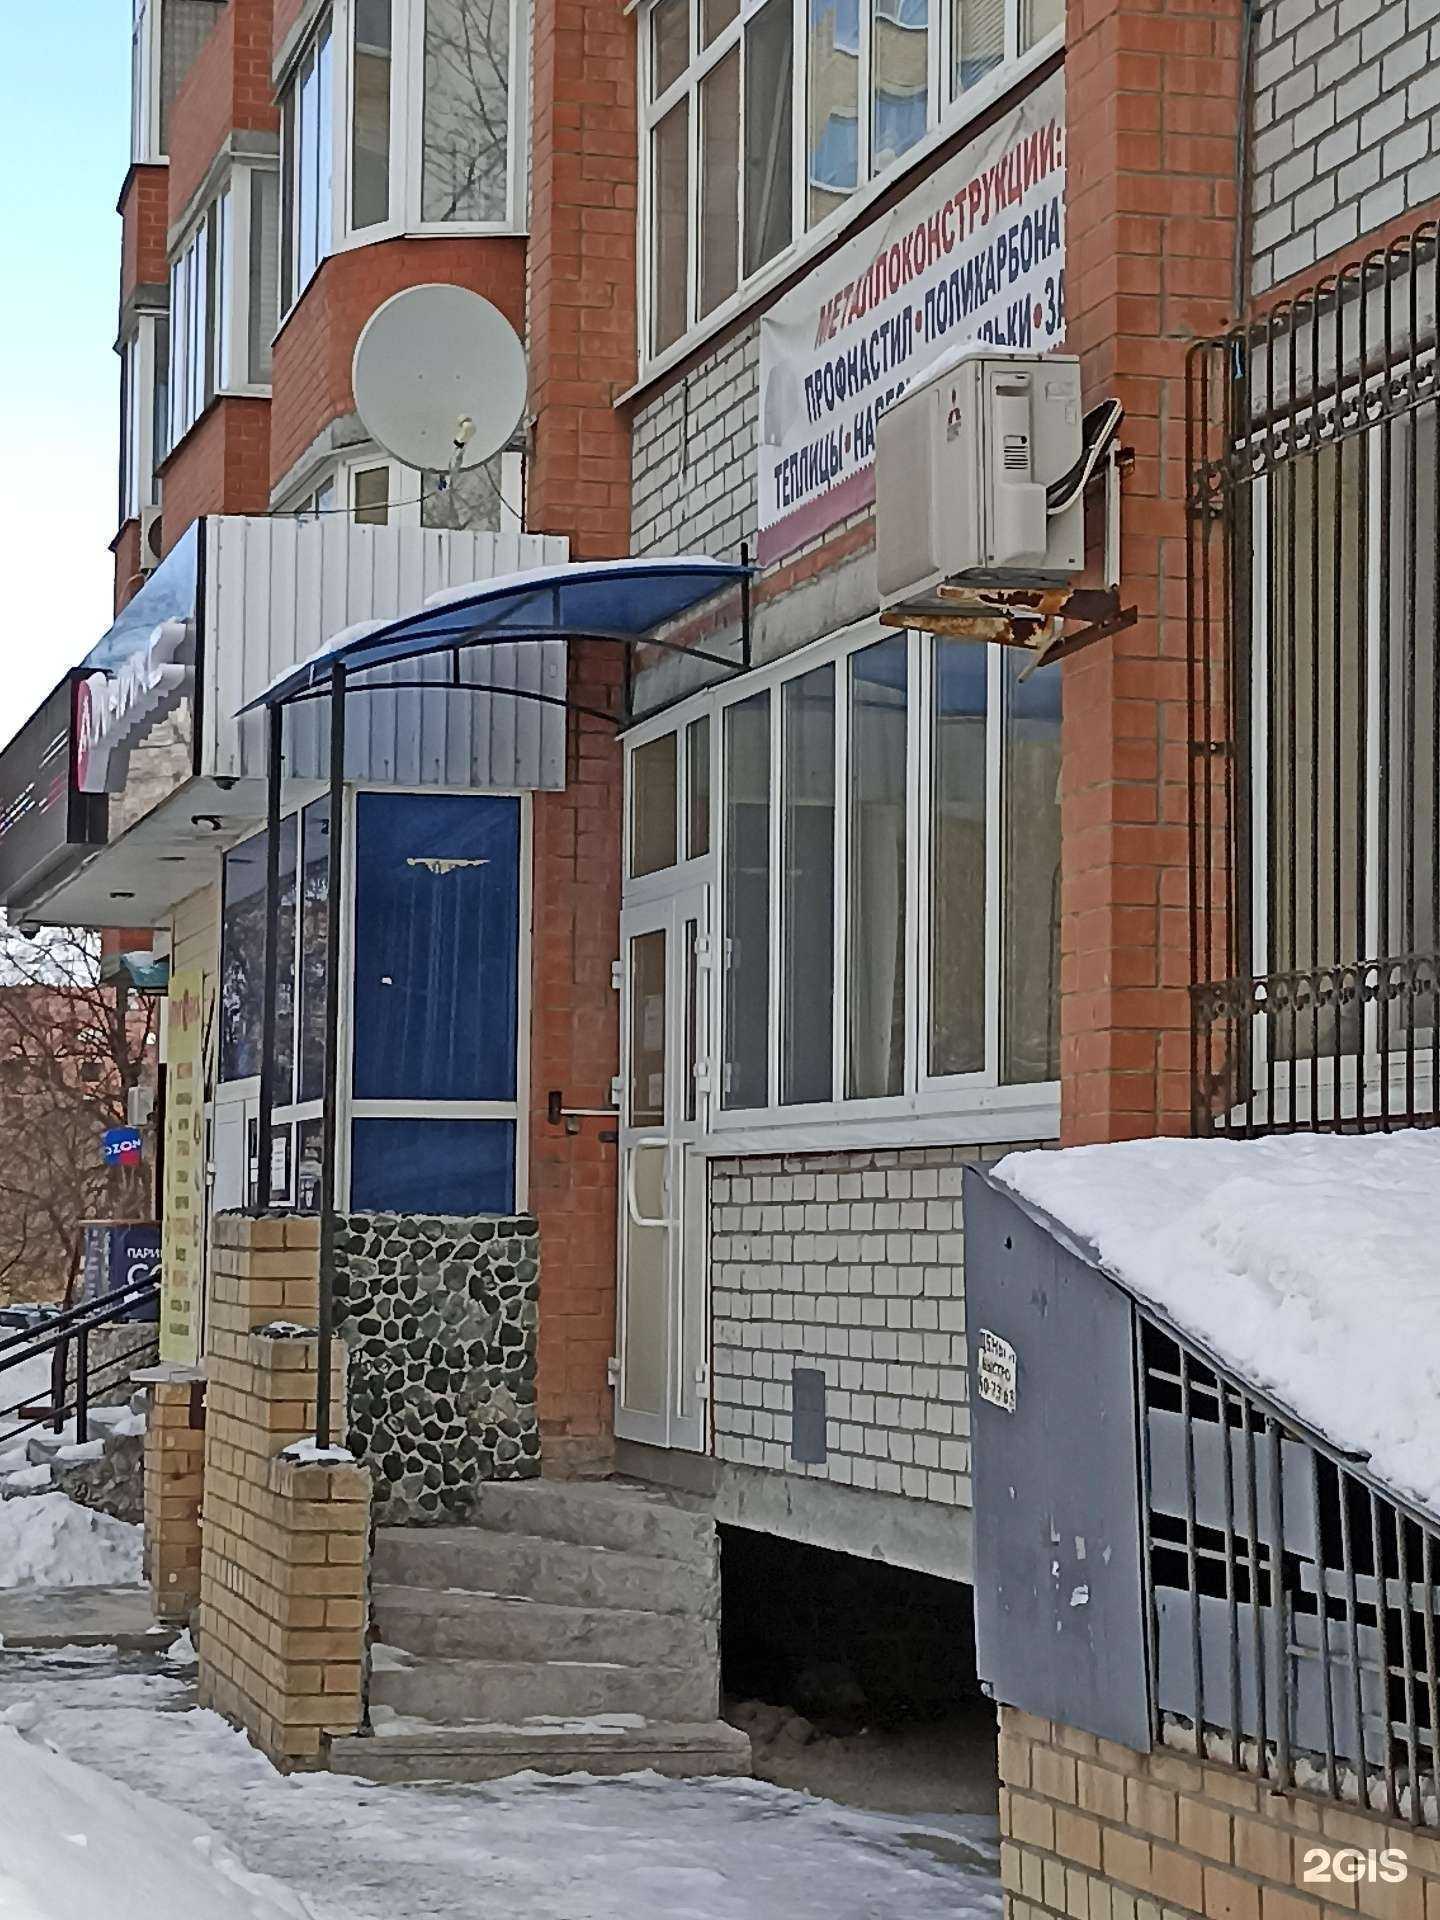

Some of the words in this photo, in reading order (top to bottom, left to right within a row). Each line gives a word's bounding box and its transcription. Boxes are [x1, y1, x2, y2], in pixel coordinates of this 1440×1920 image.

[804, 304, 913, 423] ПРОФНАСТИЛ
[925, 196, 1064, 344] ПОЛИКАРБОНА
[814, 118, 1062, 351] МЕТАЛЛОКОНСТРУКЦИИ:
[774, 424, 844, 509] ТЕПЛИЦЫ
[127, 1247, 163, 1259] ПАРИ
